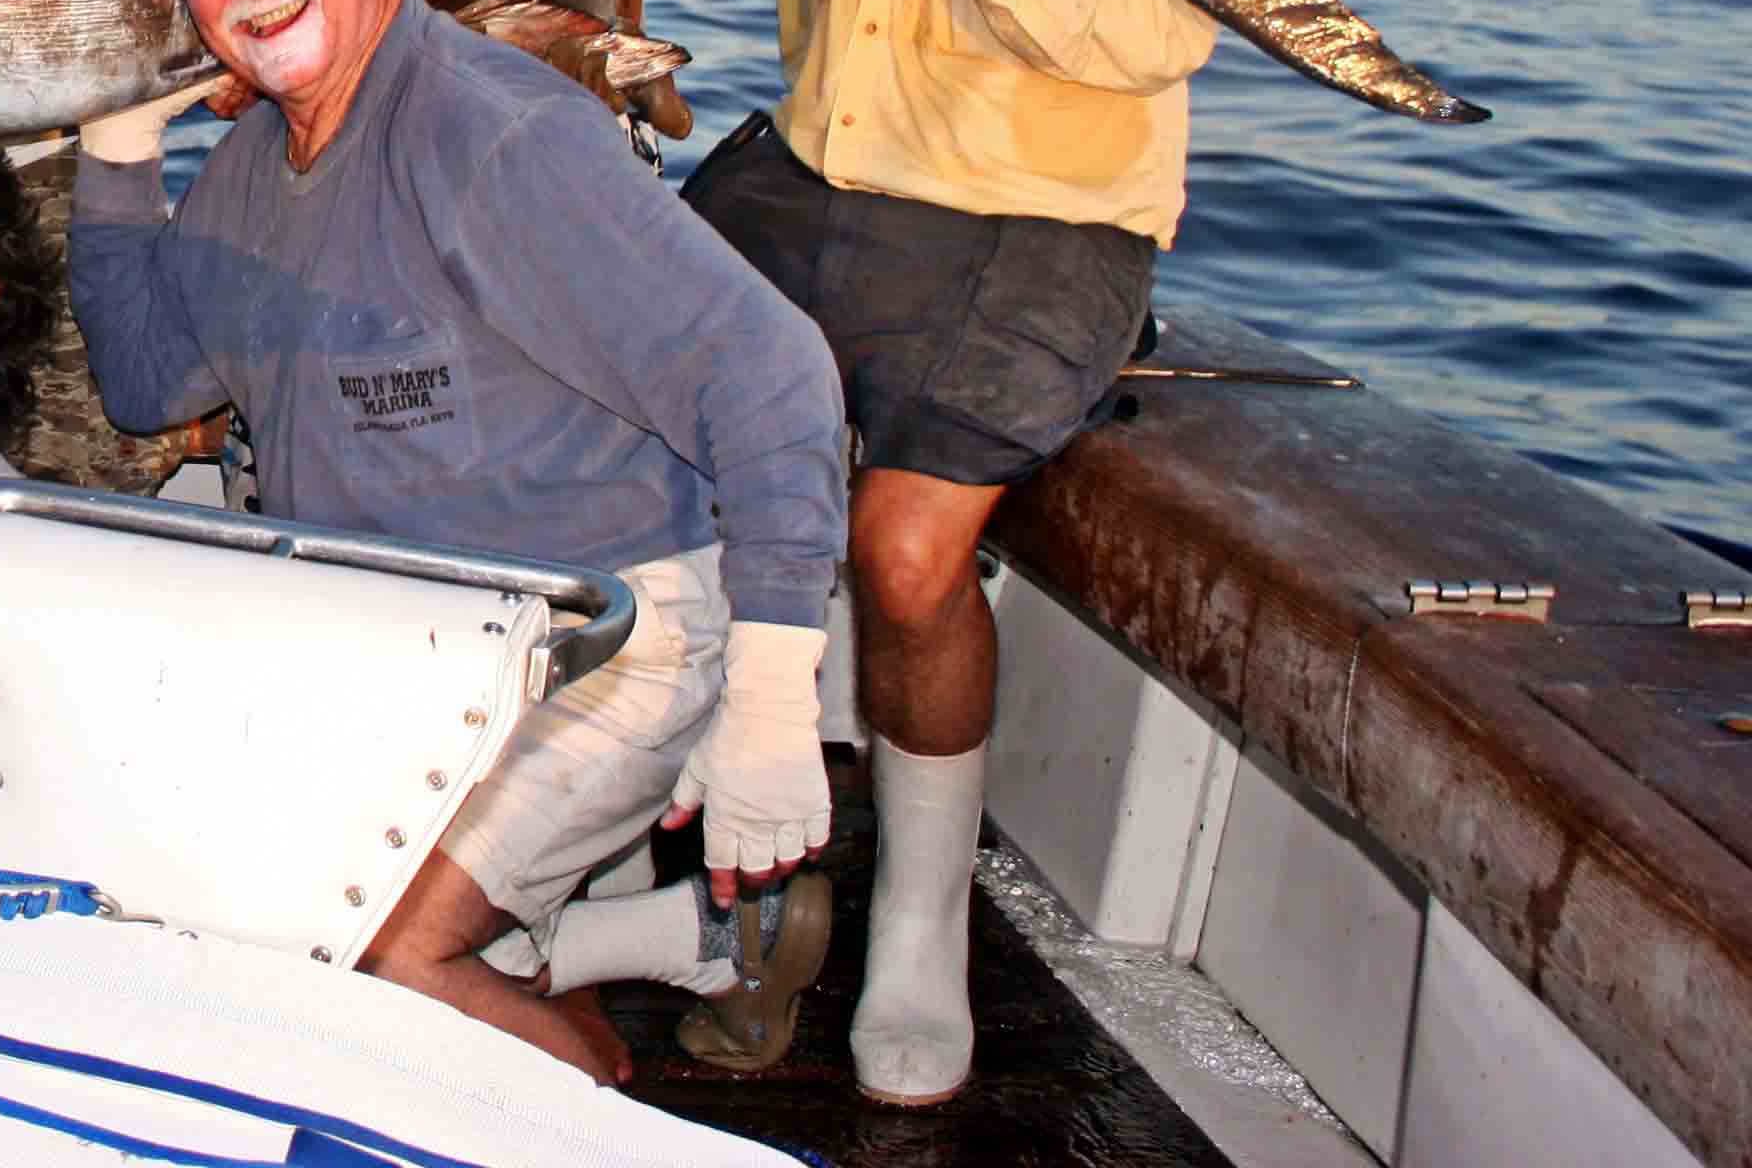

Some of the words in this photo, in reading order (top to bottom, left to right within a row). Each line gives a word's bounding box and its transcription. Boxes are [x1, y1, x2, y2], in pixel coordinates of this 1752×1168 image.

[338, 375, 369, 398] BUD
[389, 366, 450, 393] MARY'S
[362, 391, 432, 416] MARINA
